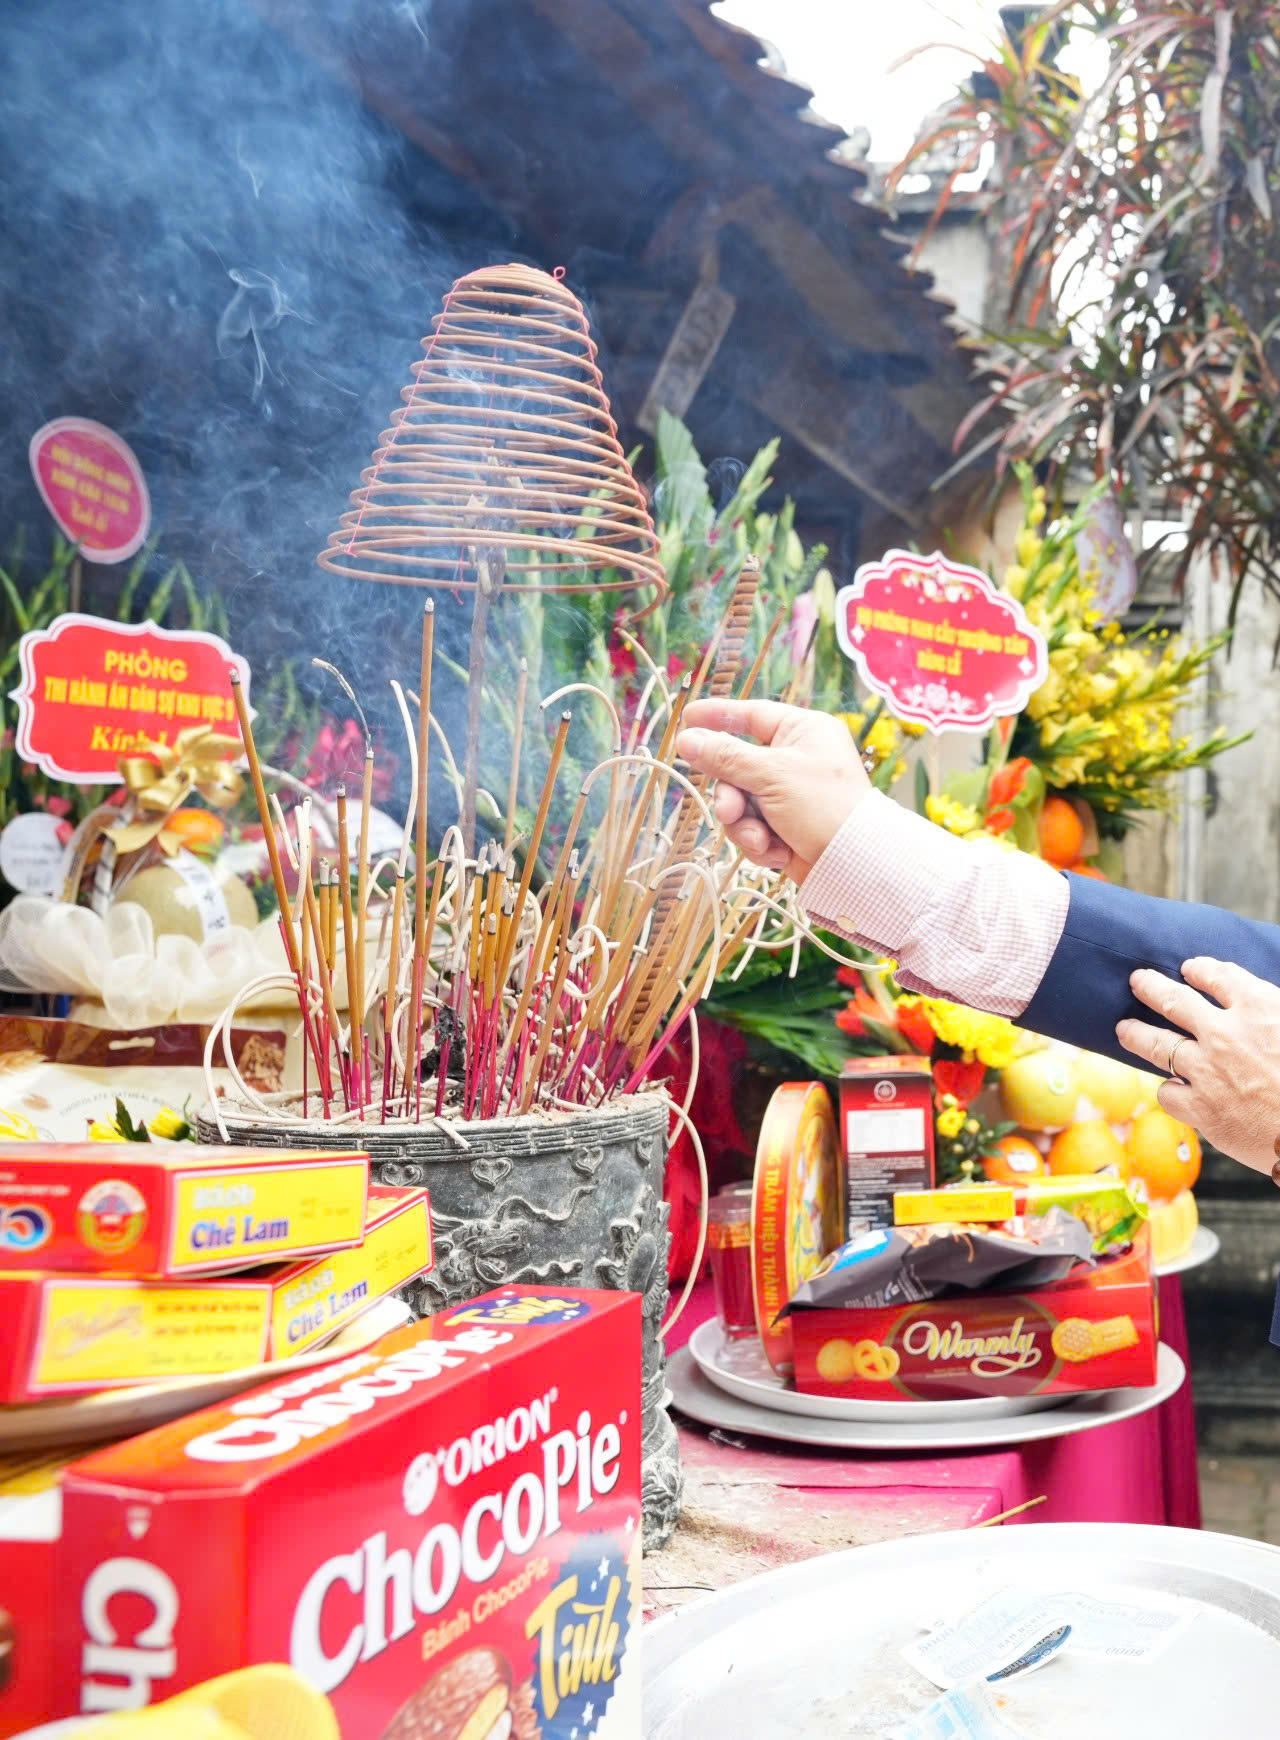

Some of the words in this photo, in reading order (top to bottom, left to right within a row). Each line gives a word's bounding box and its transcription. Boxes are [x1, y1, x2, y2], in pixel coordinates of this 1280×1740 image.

[243, 1216, 289, 1243] Lam
[329, 1280, 368, 1317] Lam
[903, 1316, 1042, 1378] Warmly
[444, 1394, 551, 1487] ORION
[290, 1410, 622, 1693] ChocoPie
[422, 1610, 471, 1661] Bánh
